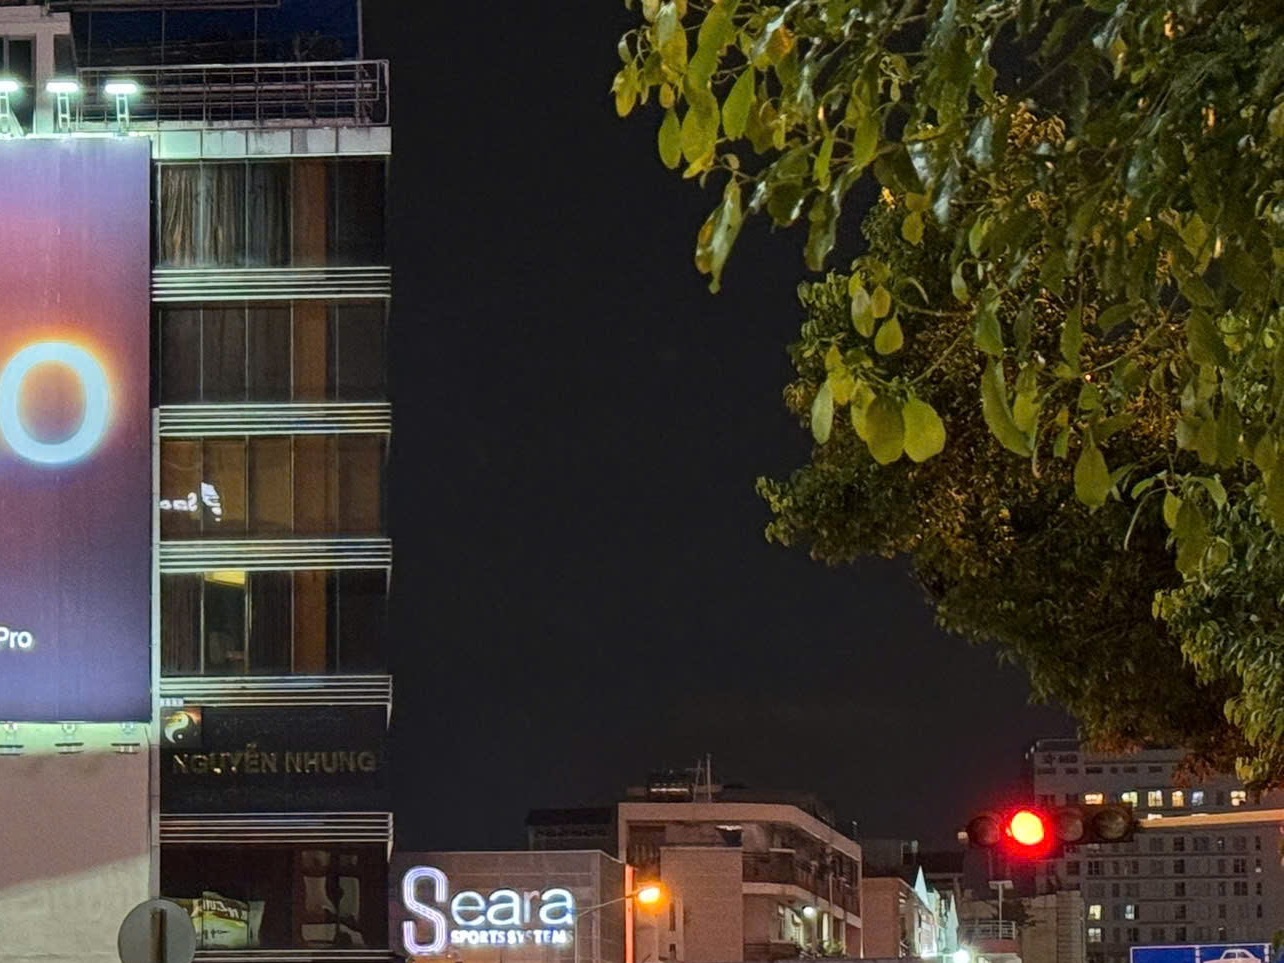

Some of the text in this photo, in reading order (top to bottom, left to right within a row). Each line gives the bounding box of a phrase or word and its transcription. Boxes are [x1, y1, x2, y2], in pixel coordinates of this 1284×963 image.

[284, 750, 378, 774] NHUNG
[402, 865, 575, 957] Seara
[450, 929, 506, 945] SPORTS
